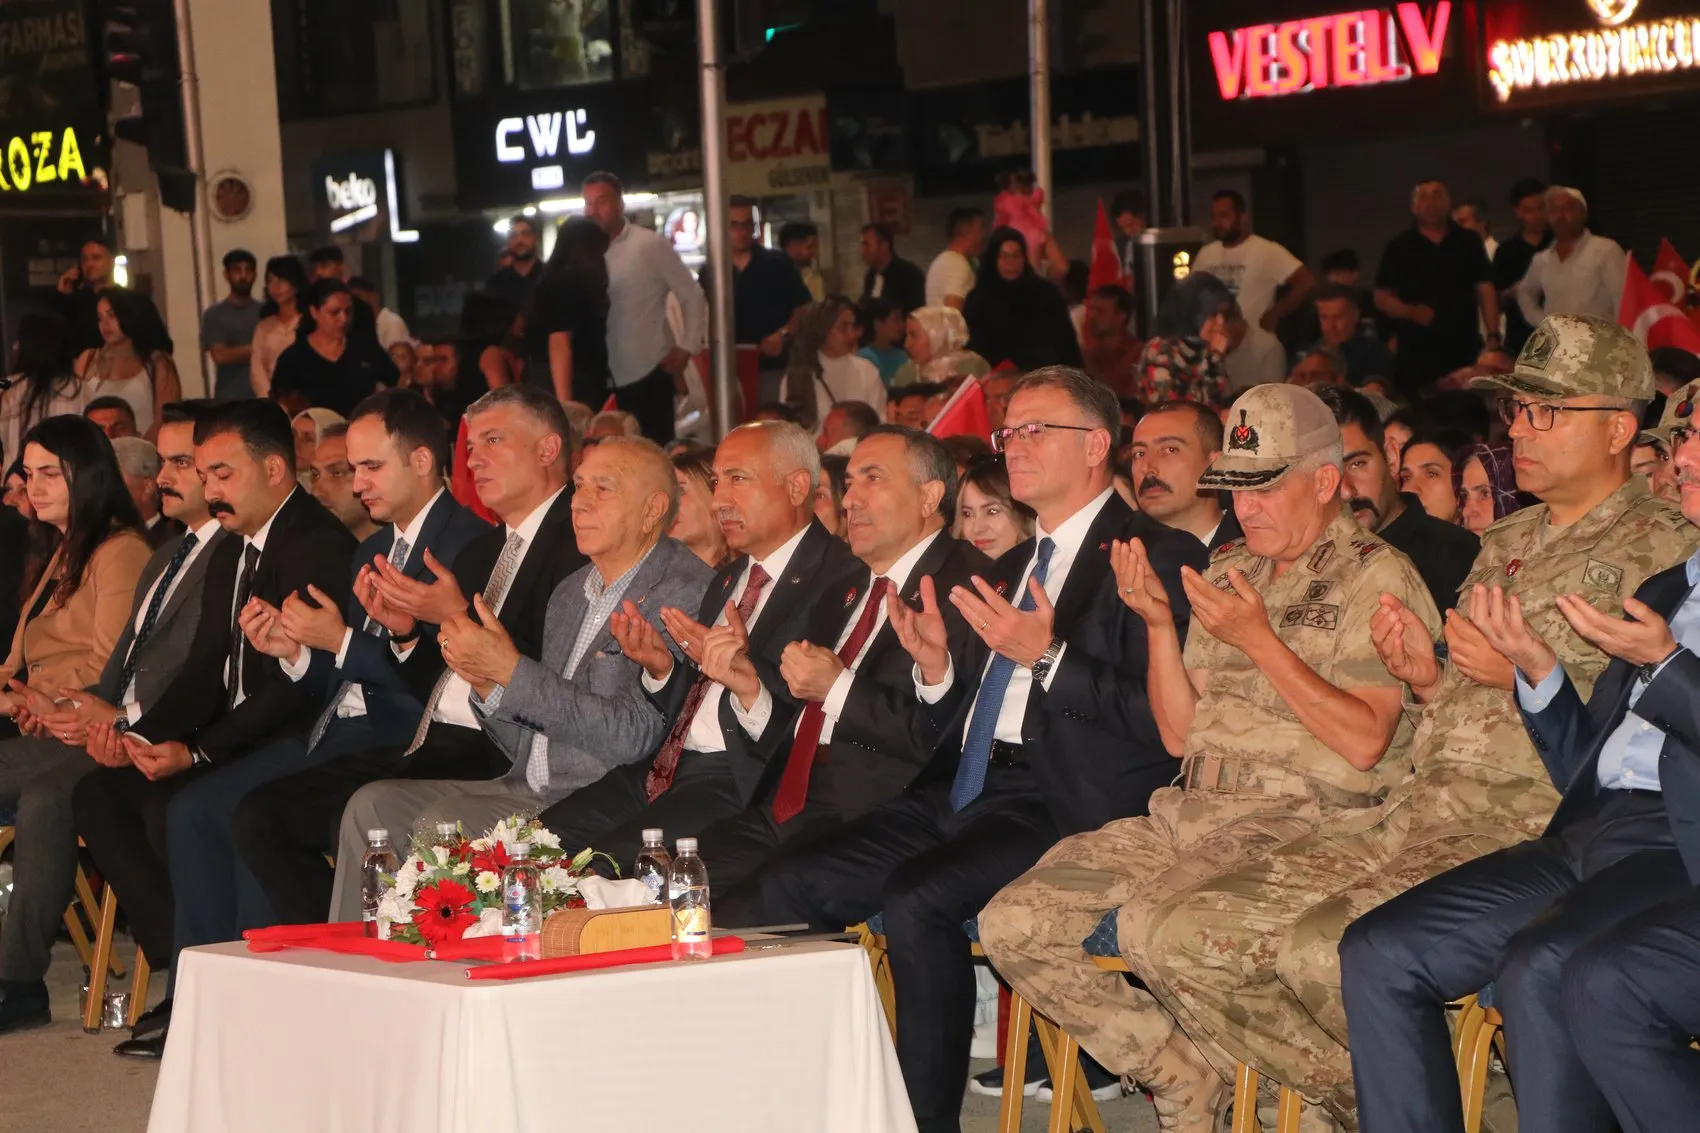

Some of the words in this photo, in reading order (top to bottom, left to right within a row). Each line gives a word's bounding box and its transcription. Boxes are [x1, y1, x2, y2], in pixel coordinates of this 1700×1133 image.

[1208, 9, 1408, 100] VESTEL
[0, 126, 87, 191] OZA
[325, 171, 377, 210] beko
